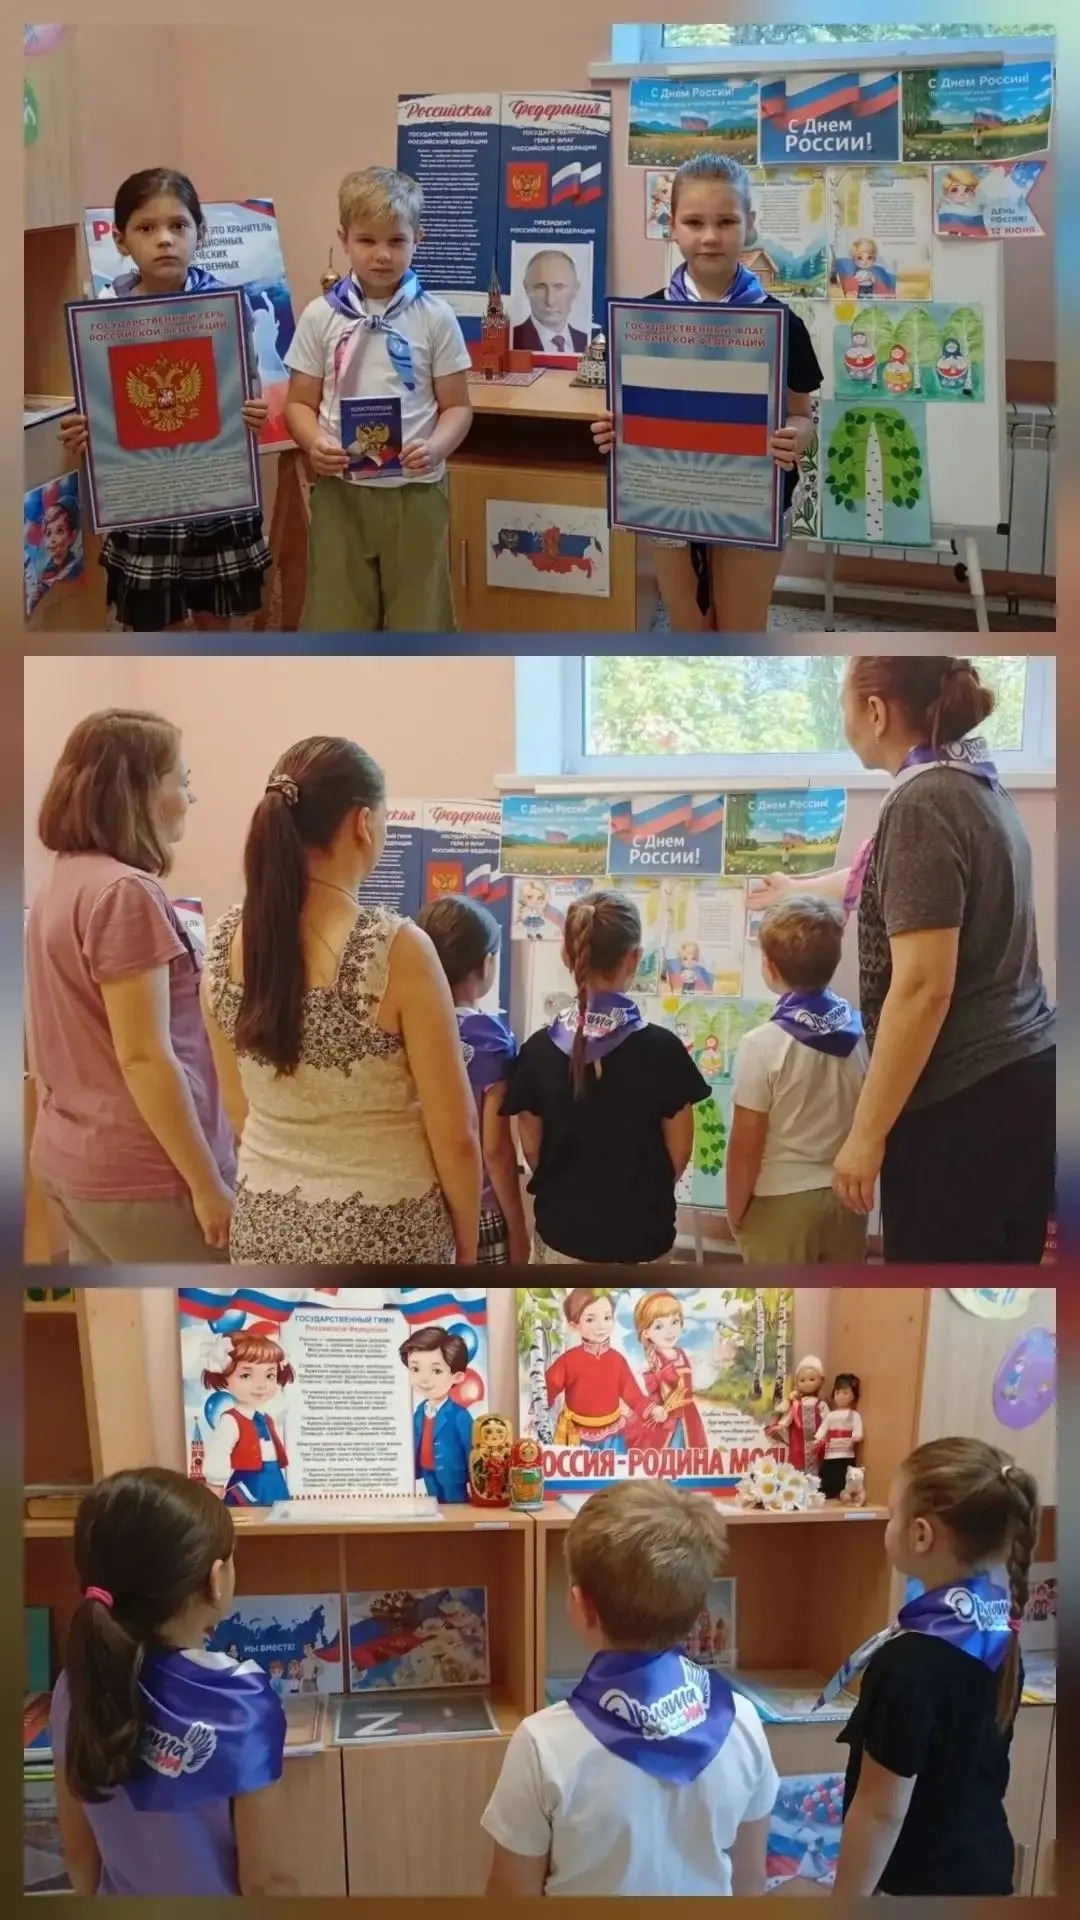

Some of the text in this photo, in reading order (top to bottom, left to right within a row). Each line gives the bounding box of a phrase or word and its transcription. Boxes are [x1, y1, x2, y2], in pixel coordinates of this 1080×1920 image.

[928, 72, 1029, 89] С Днем России!
[651, 87, 735, 99] С Днем России!
[404, 102, 493, 120] Российская
[509, 99, 601, 121] Федерация
[788, 118, 852, 136] С Днем
[785, 132, 873, 153] России!
[226, 222, 272, 234] ХРАНИТЕЛЬ
[758, 800, 786, 811] Днем
[428, 806, 501, 826] Федераци
[632, 834, 685, 850] С Днем
[628, 847, 701, 865] России!
[295, 1315, 395, 1324] ГОСУДАРСТВЕННЫЙ ГИМН
[543, 1447, 724, 1482] ОССИЯ-РОДИНА
[354, 1711, 403, 1737] Z
